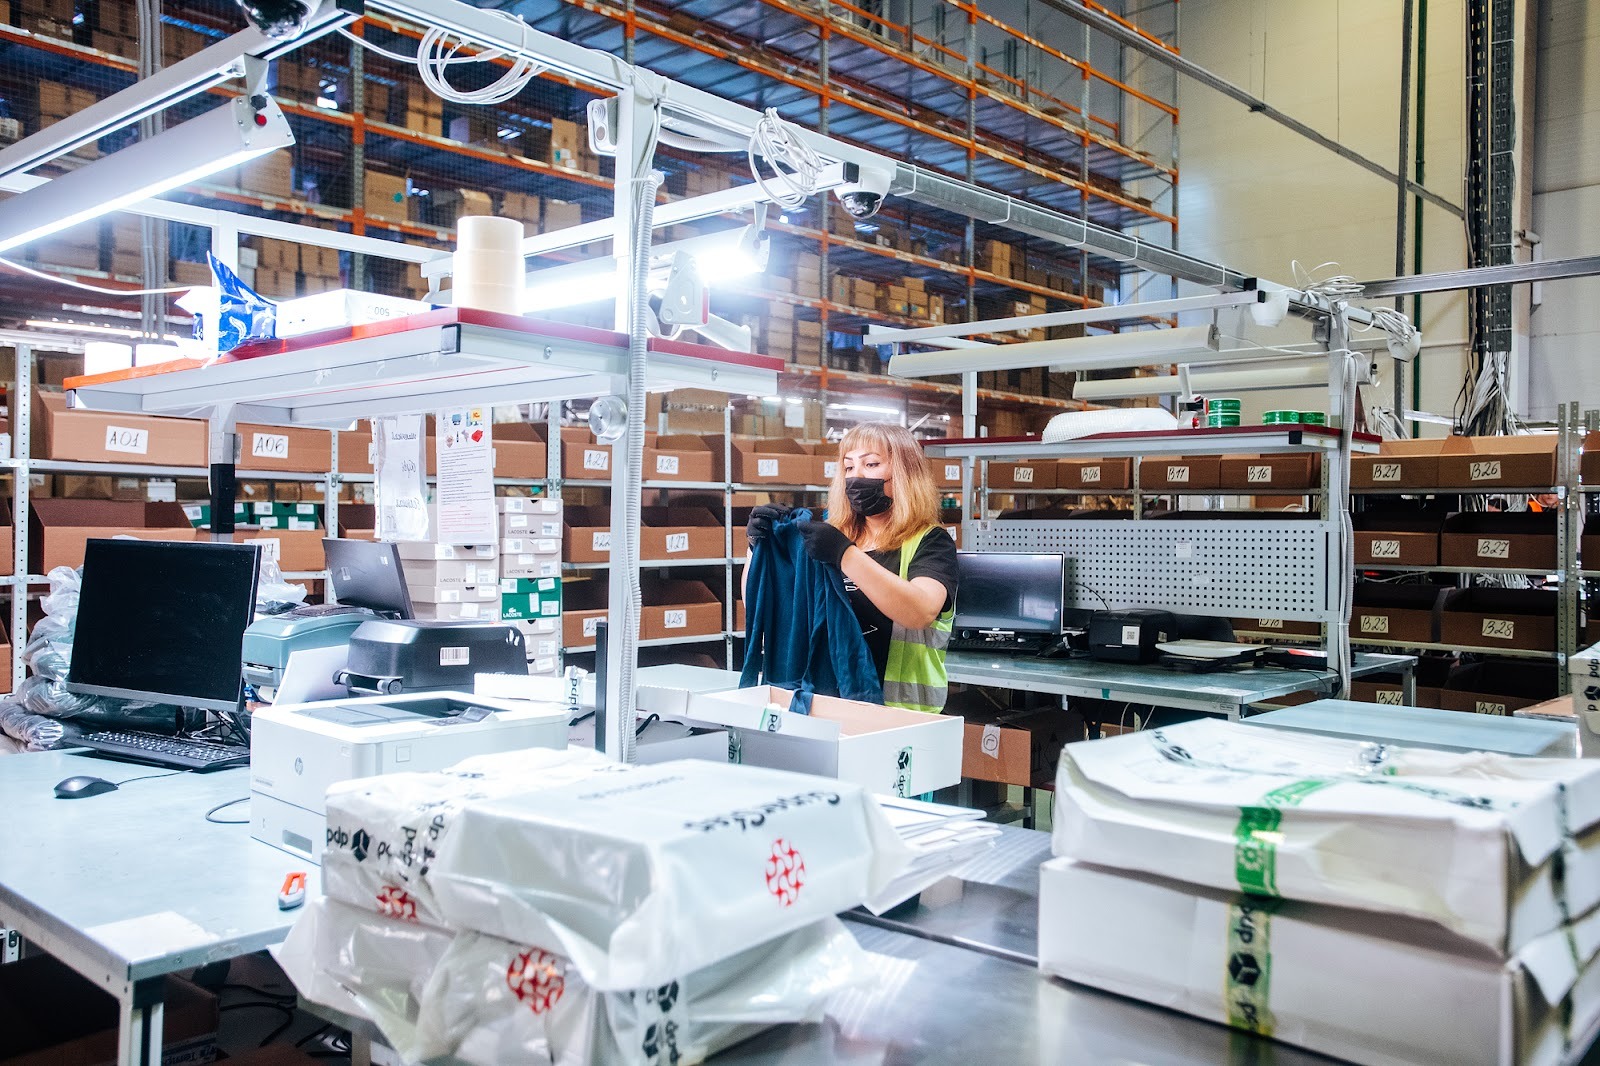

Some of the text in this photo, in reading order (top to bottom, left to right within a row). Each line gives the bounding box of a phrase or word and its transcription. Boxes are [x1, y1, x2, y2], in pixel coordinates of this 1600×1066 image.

[110, 431, 140, 447] A01
[254, 436, 285, 454] A06
[1015, 468, 1033, 480] B01
[1081, 468, 1099, 481] B06
[1167, 467, 1186, 480] B11
[1248, 466, 1269, 481] B16
[1373, 464, 1399, 479] B21
[1471, 462, 1500, 480] B26
[1372, 541, 1399, 555] B22
[1478, 540, 1509, 555] B27
[1362, 616, 1387, 632] B23
[1482, 620, 1514, 637] B28
